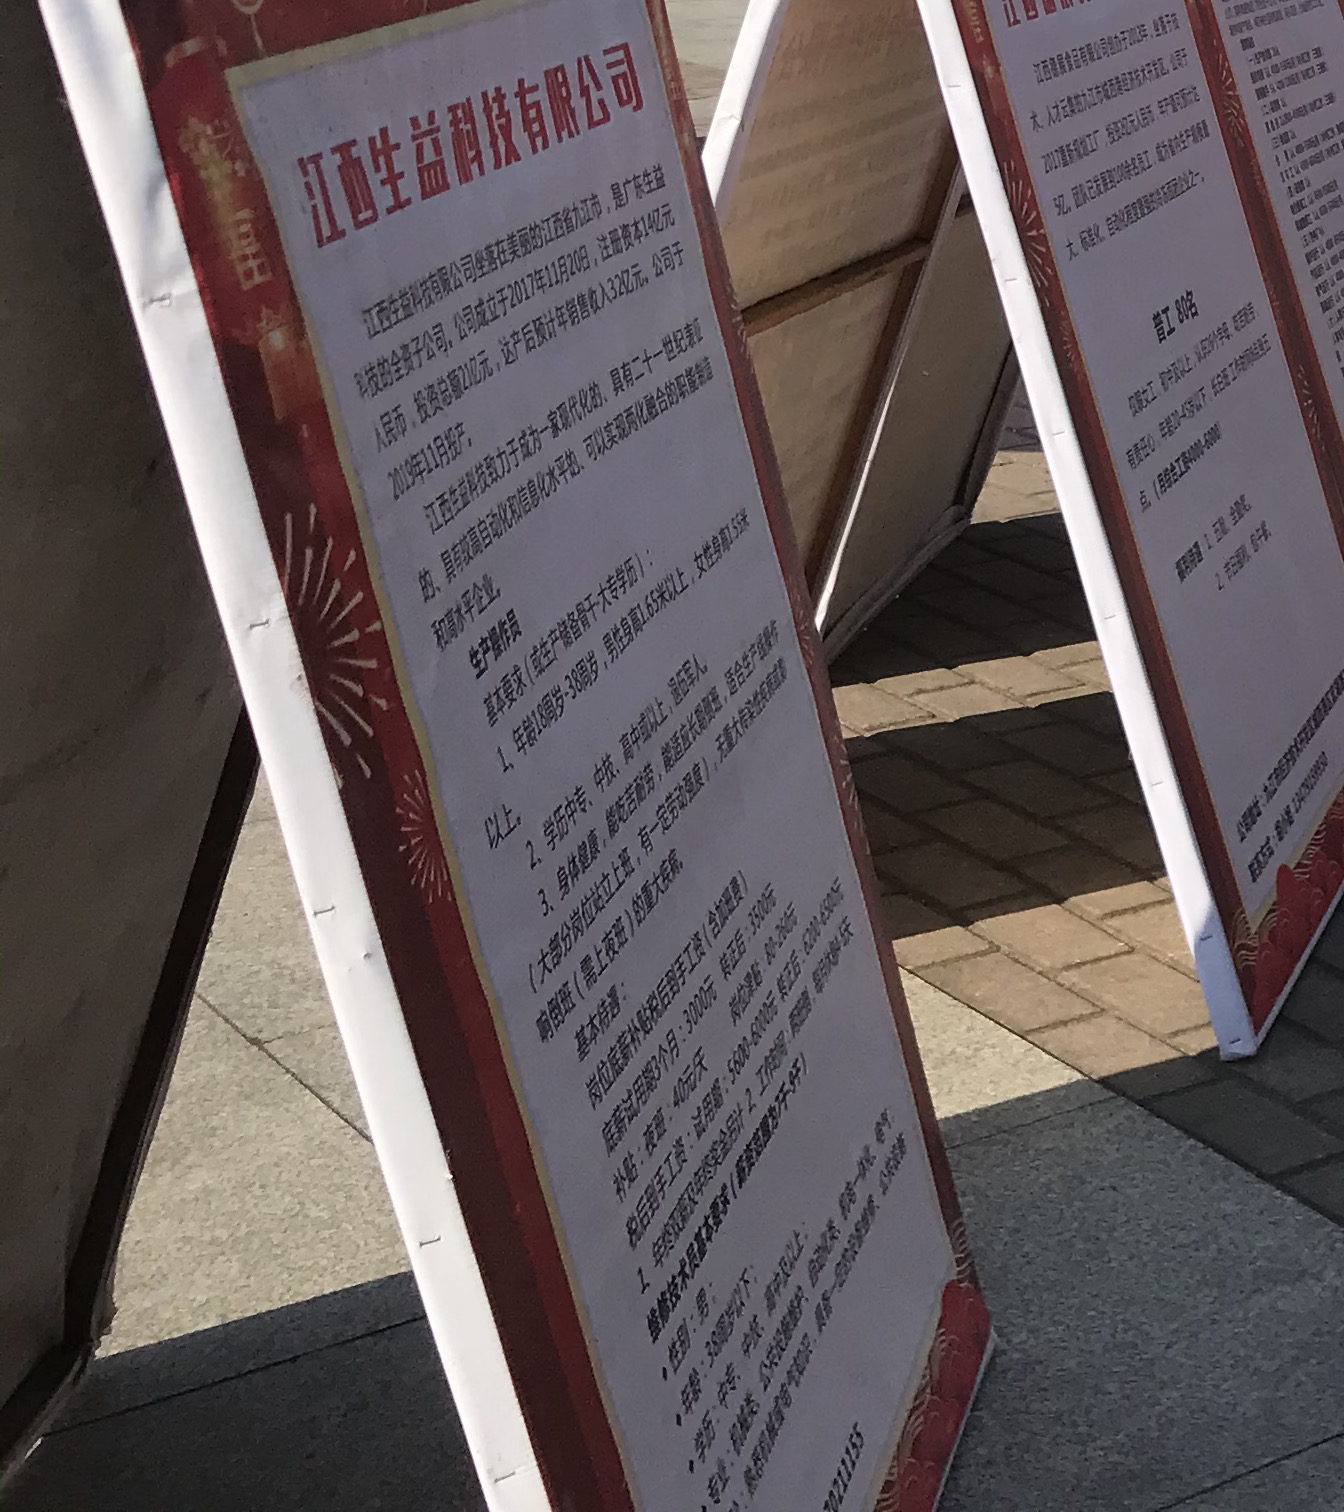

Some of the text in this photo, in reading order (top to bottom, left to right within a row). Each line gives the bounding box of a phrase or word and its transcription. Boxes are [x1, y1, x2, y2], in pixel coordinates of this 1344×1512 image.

[292, 39, 646, 247] 江西生益科技有限公司
[1150, 285, 1199, 345] 普工 80名
[466, 606, 524, 681] 生产操作员
